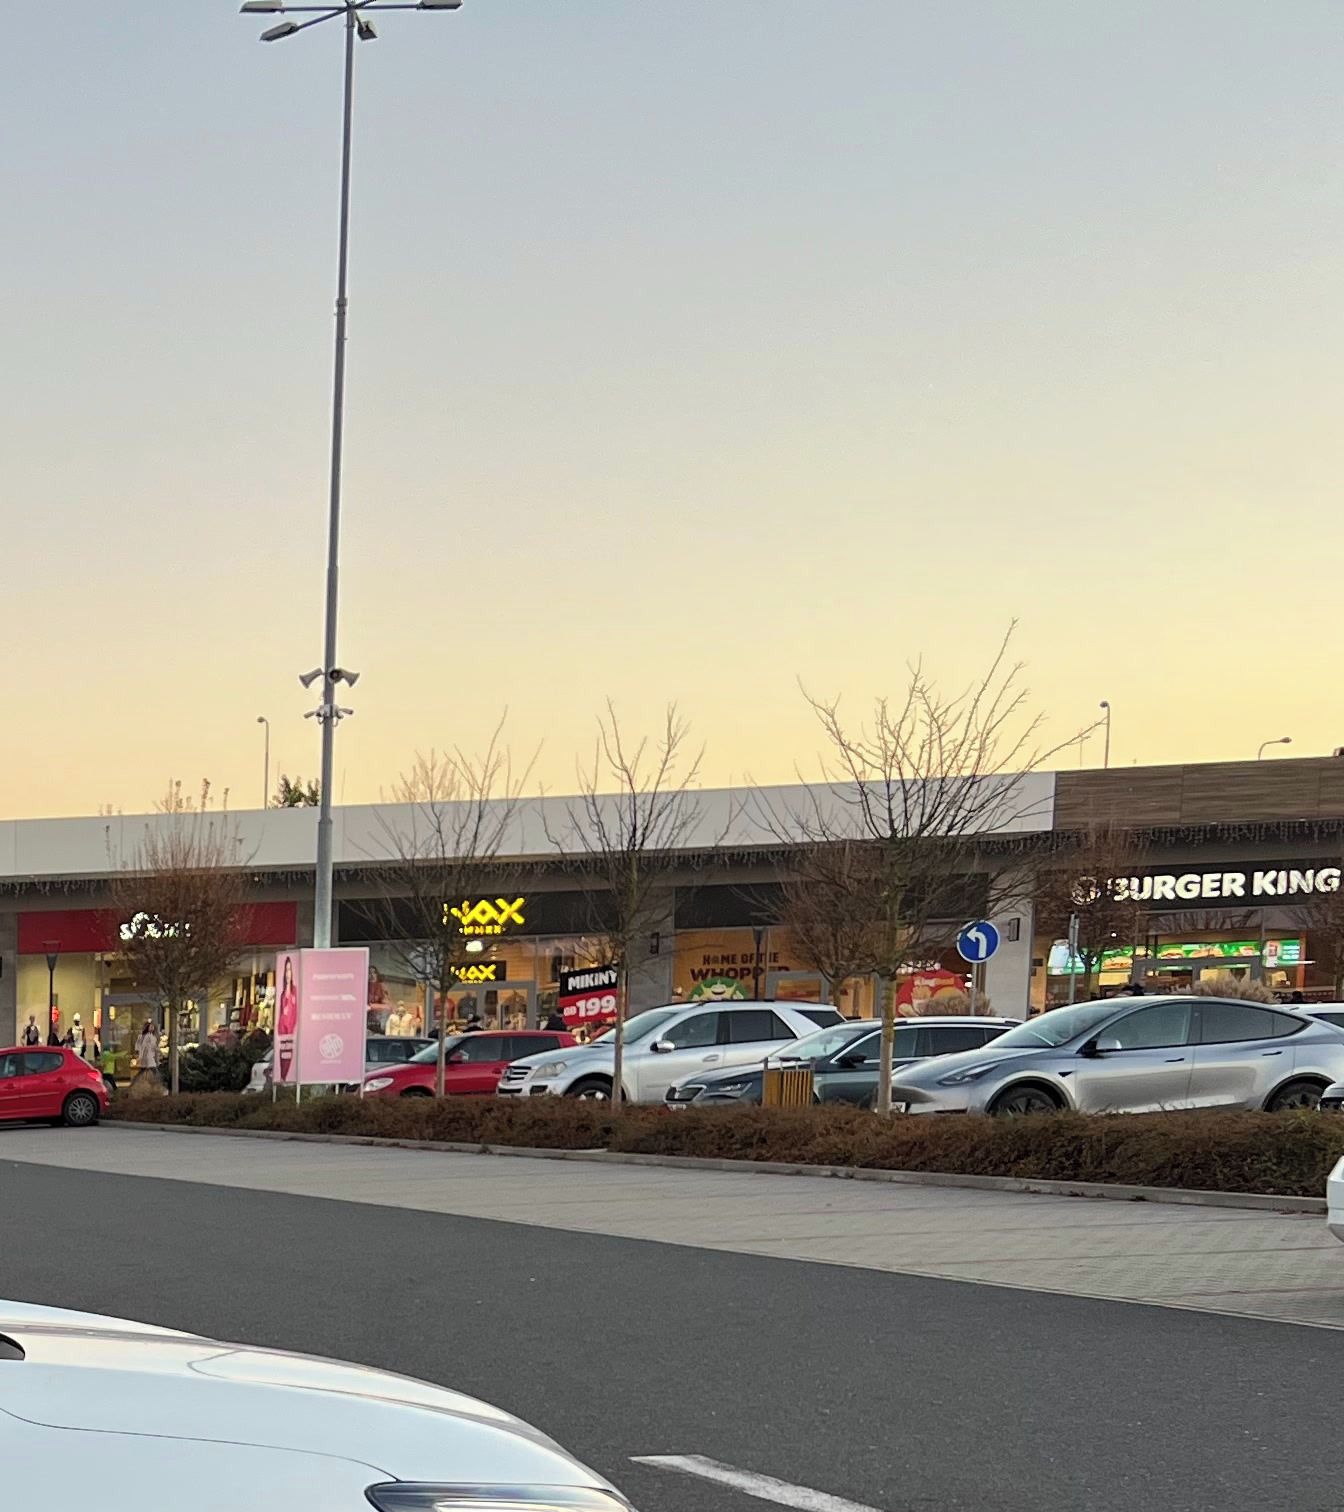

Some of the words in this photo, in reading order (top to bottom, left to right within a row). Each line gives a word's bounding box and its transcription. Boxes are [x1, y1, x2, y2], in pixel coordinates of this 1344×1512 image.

[1107, 871, 1246, 900] BURGER
[1251, 867, 1342, 896] KING
[567, 970, 617, 991] MIKINY
